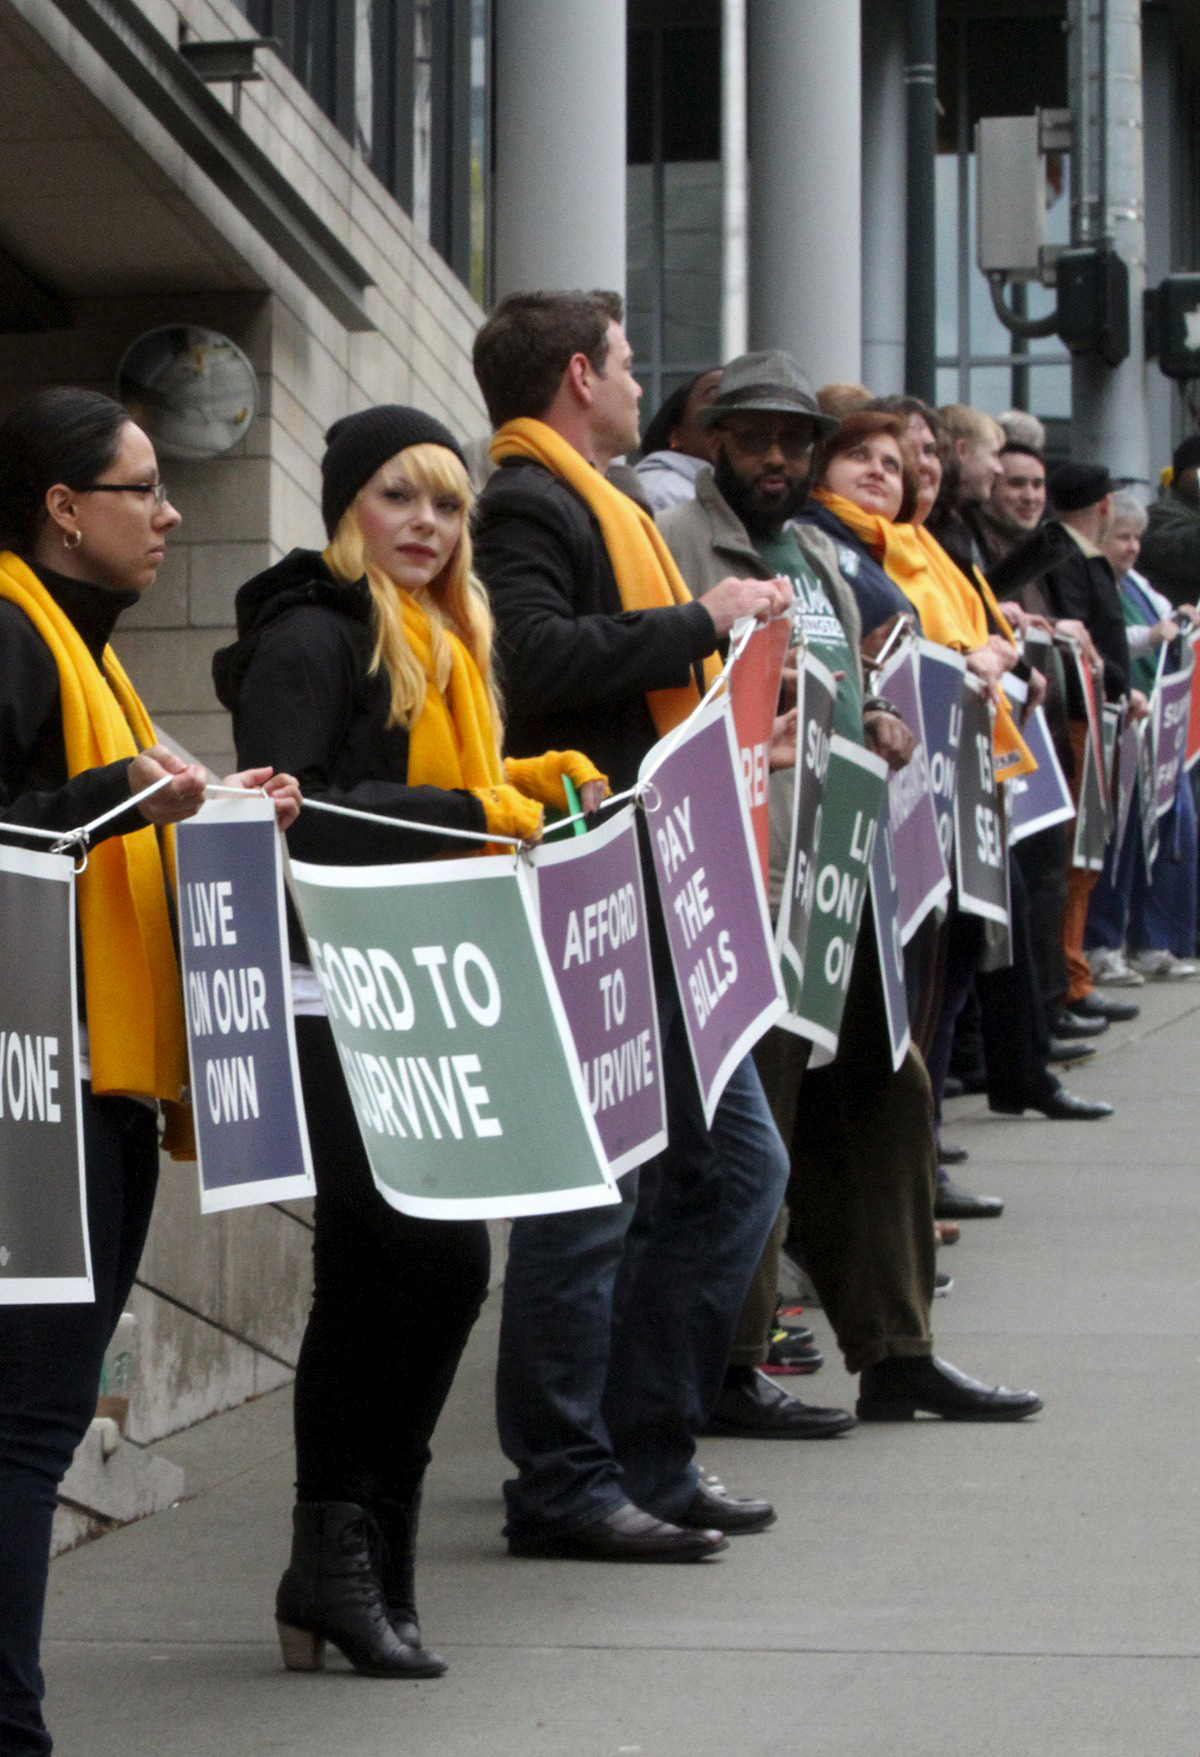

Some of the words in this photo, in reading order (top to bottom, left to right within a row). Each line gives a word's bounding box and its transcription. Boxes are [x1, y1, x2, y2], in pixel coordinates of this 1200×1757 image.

[740, 742, 770, 809] RE
[657, 796, 696, 884] PAY
[187, 881, 238, 947] LIVE
[562, 882, 639, 971] AFFORD
[674, 867, 716, 950] THE
[190, 971, 213, 1037] ON
[213, 967, 270, 1035] OUR
[411, 942, 502, 1027] TO
[600, 967, 627, 1032] TO
[688, 930, 739, 1030] BILLS
[206, 1055, 260, 1125] OWN
